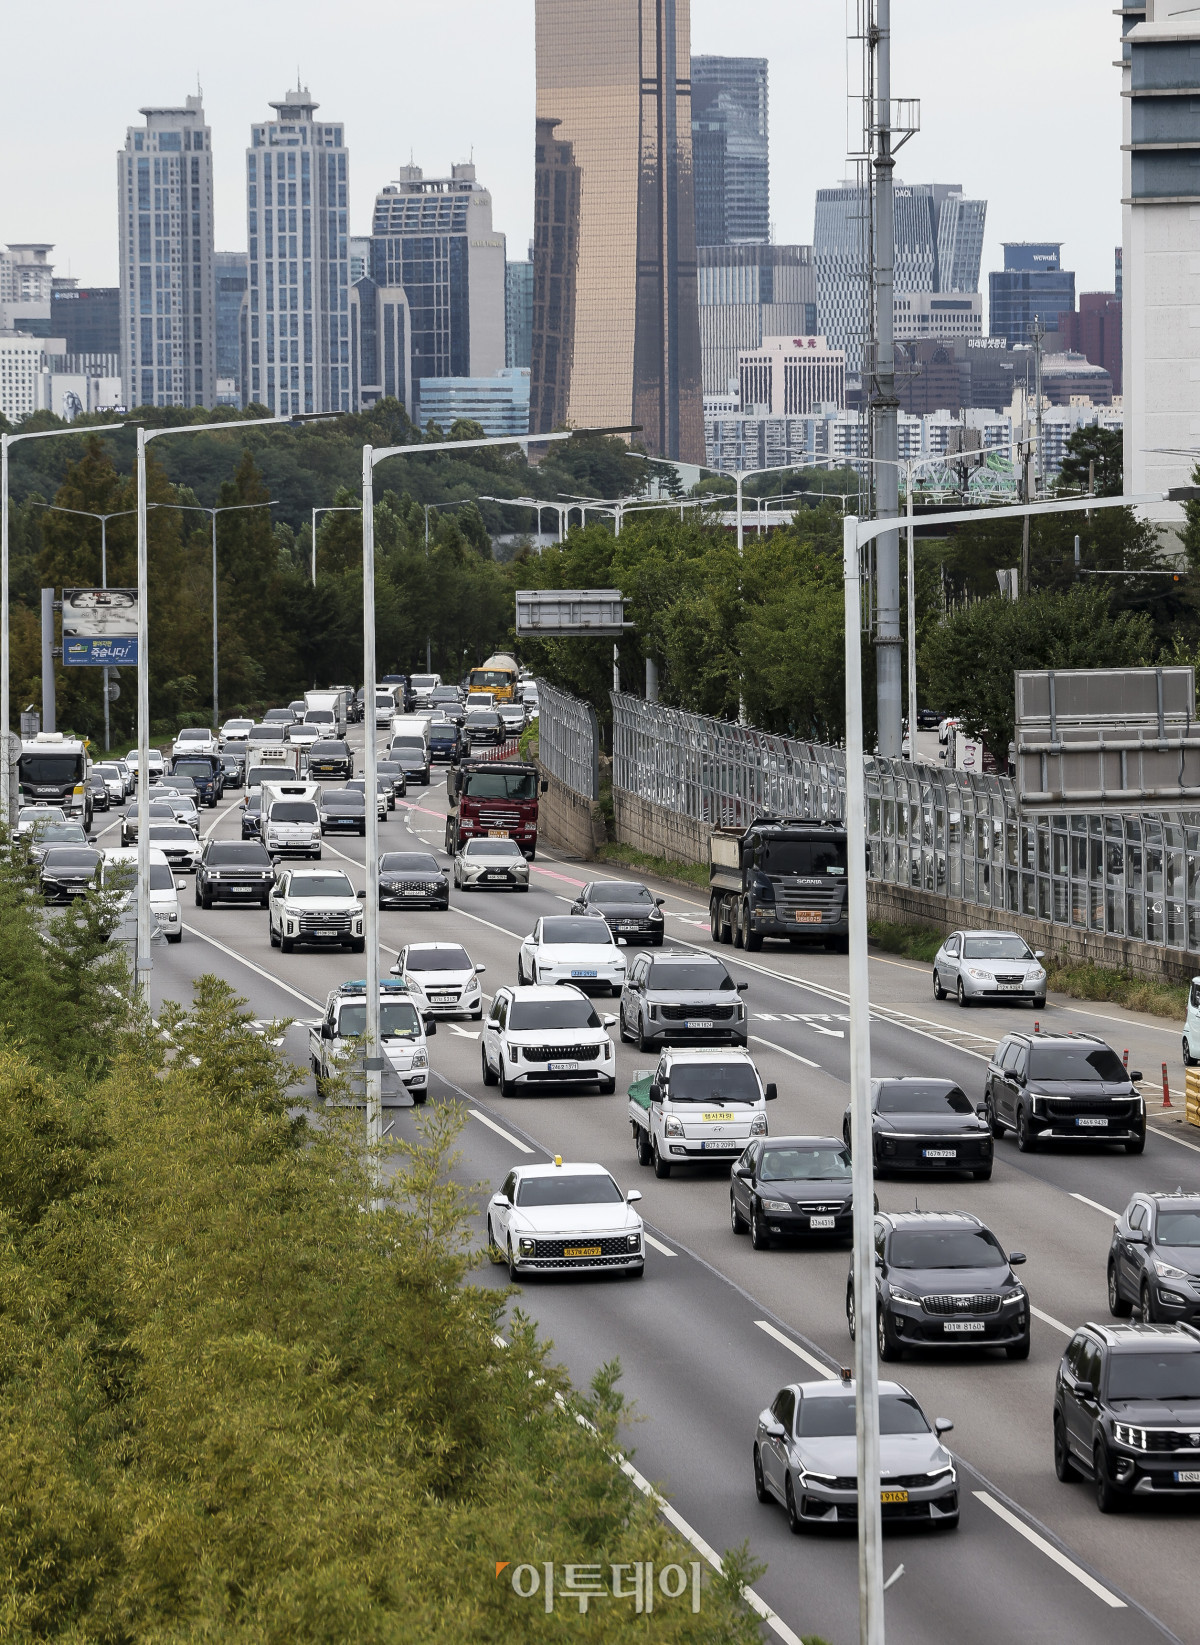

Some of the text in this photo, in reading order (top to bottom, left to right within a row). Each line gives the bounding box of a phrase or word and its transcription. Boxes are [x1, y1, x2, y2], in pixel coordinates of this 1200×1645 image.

[895, 189, 912, 198] DAOL
[1033, 252, 1057, 261] wework
[968, 338, 1007, 349] 미래에셋증권
[91, 647, 129, 657] 죽습니다!
